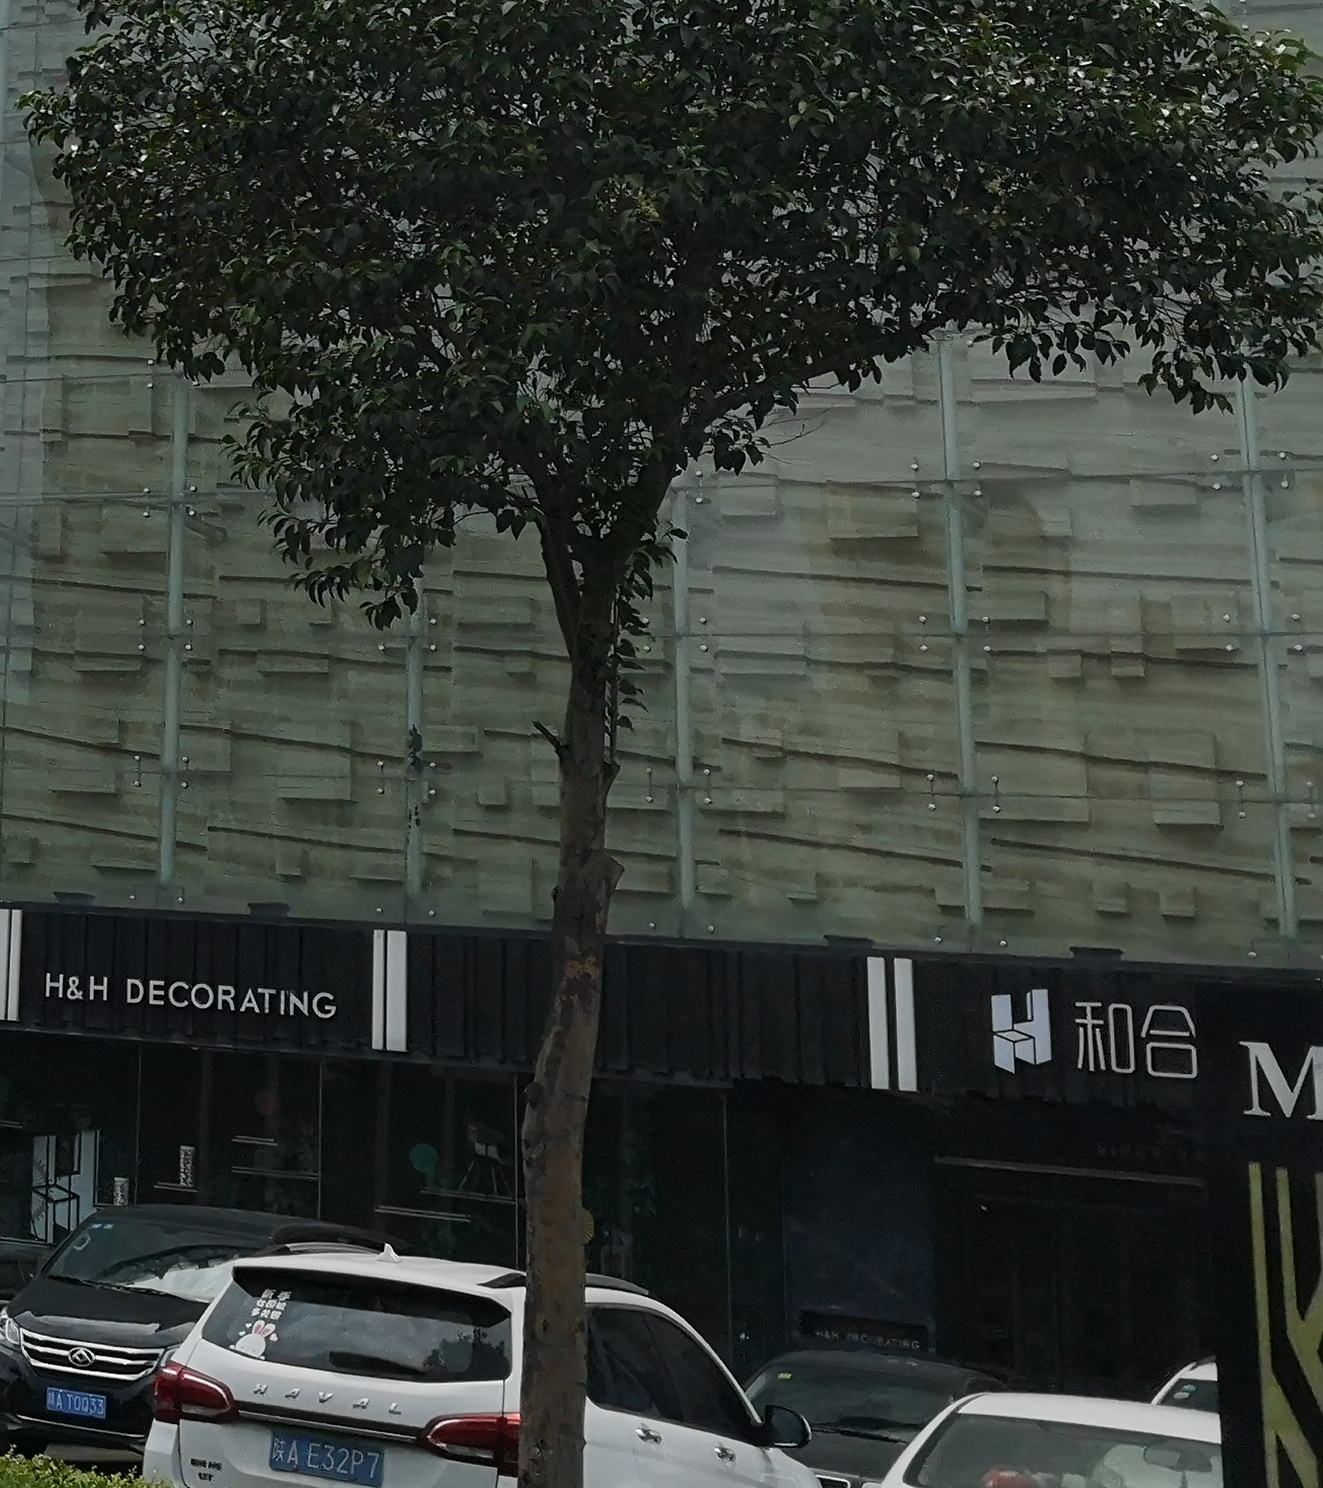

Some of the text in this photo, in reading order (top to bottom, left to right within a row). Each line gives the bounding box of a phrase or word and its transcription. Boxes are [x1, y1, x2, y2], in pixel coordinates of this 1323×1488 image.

[45, 973, 338, 1019] H&H DECORATING
[1075, 1001, 1198, 1079] 和合
[254, 1383, 402, 1415] HAVAL
